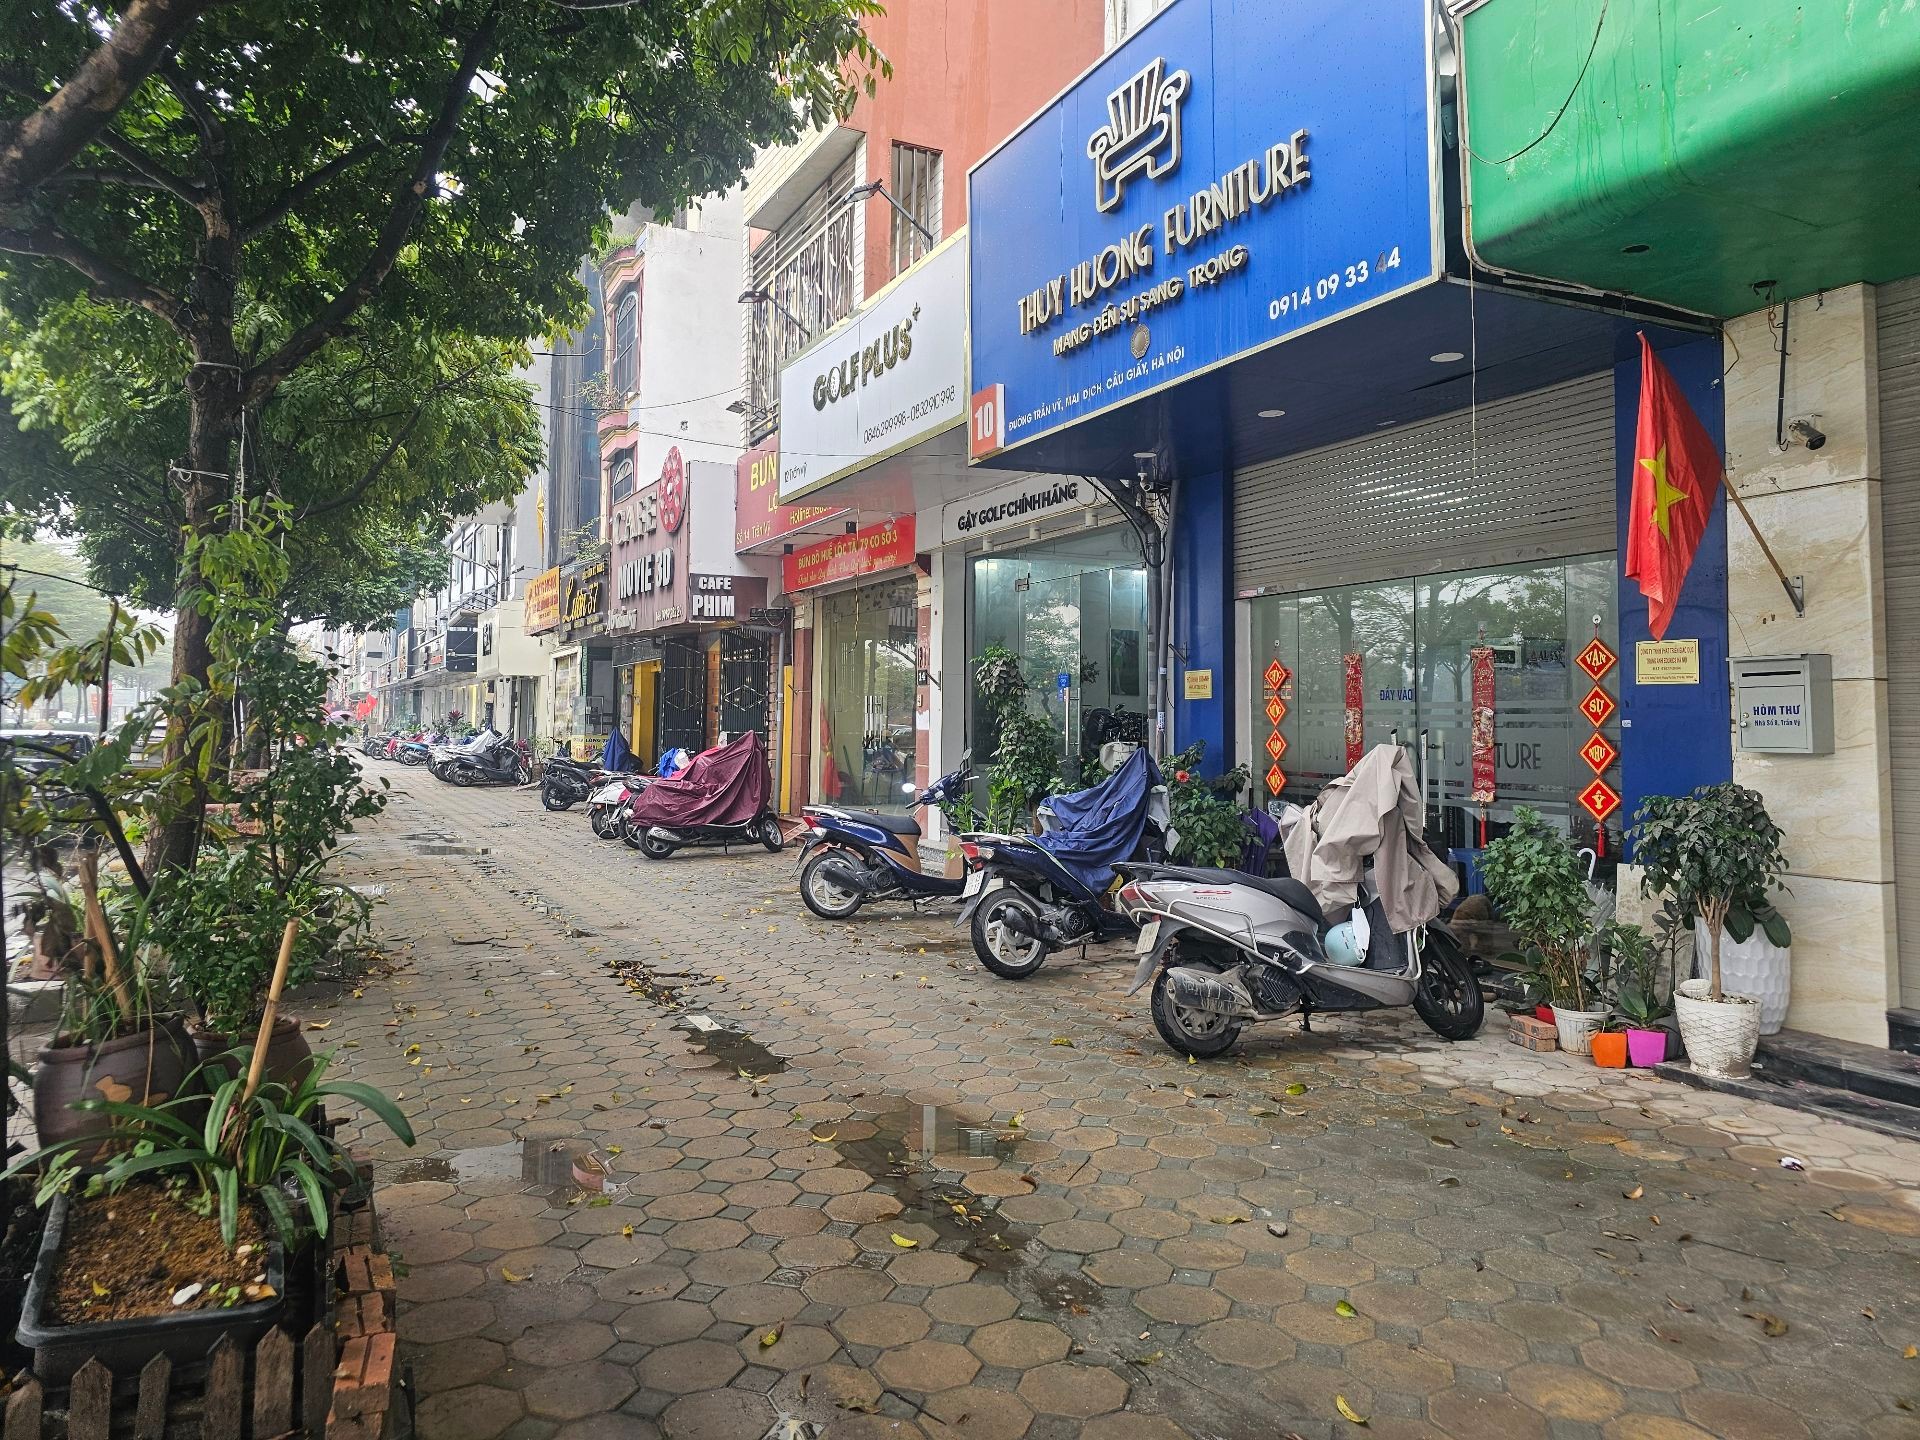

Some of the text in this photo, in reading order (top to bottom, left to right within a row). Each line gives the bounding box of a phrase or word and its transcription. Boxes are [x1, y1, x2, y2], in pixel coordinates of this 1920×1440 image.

[1018, 128, 1312, 335] THUY HUONG FURNITURE
[1053, 324, 1093, 356] MANG
[1094, 302, 1121, 334] ĐẾN
[1140, 277, 1184, 311] SANG
[1188, 244, 1250, 289] TRỌNG
[1269, 286, 1312, 320] 0914
[1317, 273, 1340, 300] 09
[1345, 260, 1369, 288] 33
[1065, 393, 1080, 408] MAI
[1106, 370, 1124, 390] CẦU
[1152, 352, 1165, 370] HÀ
[1166, 346, 1185, 365] NỘI
[974, 399, 995, 442] 10
[614, 491, 657, 546] CAFE
[957, 509, 978, 532] GẬY
[978, 503, 1007, 526] GOLF
[1007, 492, 1042, 518] CHÍNH
[618, 553, 653, 600] MOVIE
[655, 547, 673, 588] 3D
[698, 576, 732, 590] CAFE
[692, 594, 735, 617] PHIM
[918, 672, 926, 682] 14
[1585, 648, 1607, 672] VẠN
[1753, 703, 1801, 716] HÒM THƯ
